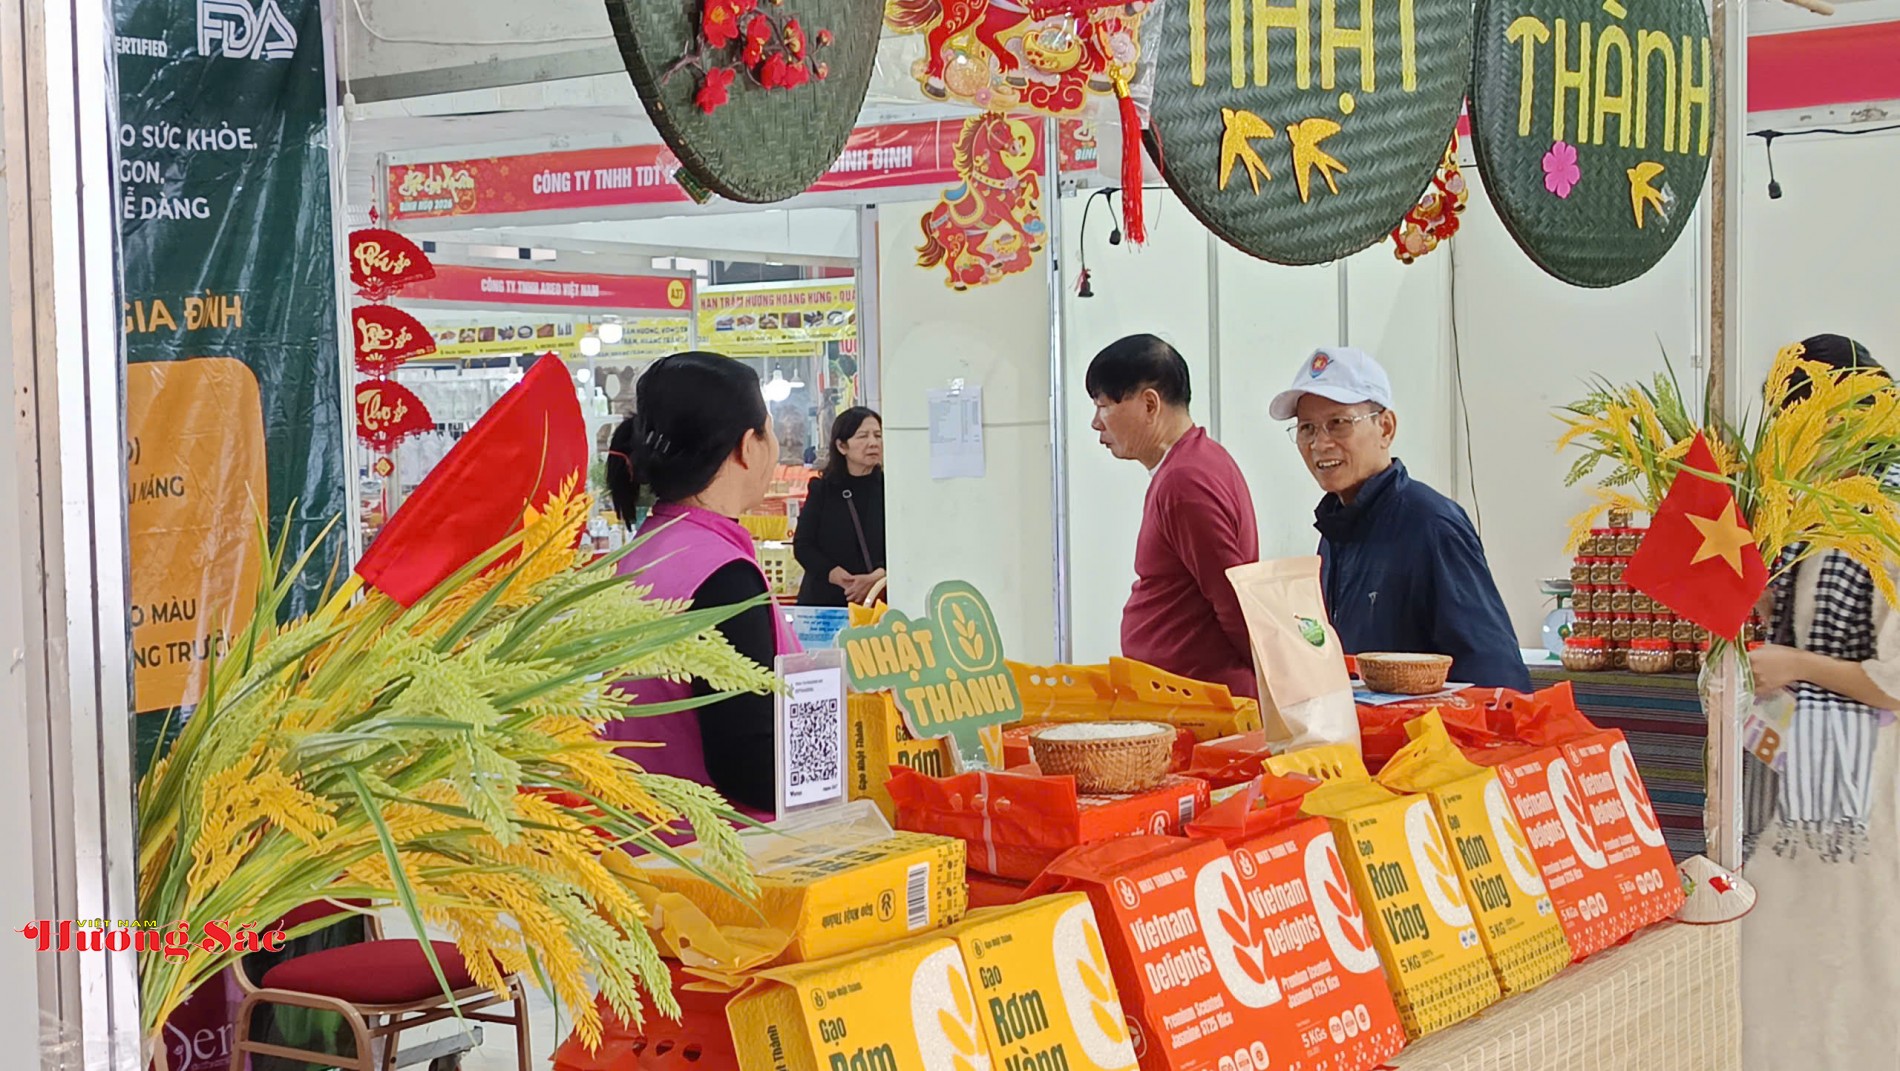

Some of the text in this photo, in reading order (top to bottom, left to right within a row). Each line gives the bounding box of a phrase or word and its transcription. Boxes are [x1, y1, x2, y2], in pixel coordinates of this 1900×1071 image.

[197, 0, 298, 60] FDA
[142, 121, 182, 150] SỨC
[186, 121, 258, 151] KHỎE.
[120, 159, 165, 185] GON.
[872, 145, 913, 174] ĐỊNH
[532, 168, 571, 195] CÔNG
[574, 172, 593, 191] TY
[594, 167, 632, 190] TNHH
[140, 191, 210, 220] DÀNG
[481, 276, 505, 294] CÔNG
[505, 280, 516, 293] TY
[562, 280, 579, 299] VIỆT
[184, 288, 242, 330] ĐÌNH
[357, 388, 391, 431] Thọ
[151, 595, 196, 625] MÀU
[846, 621, 936, 682] NHẬT
[905, 667, 1015, 726] THÀNH
[895, 725, 913, 746] Gạ
[1578, 771, 1616, 798] Vietnam
[1513, 790, 1555, 820] Vietnam
[1589, 797, 1626, 826] Delights
[1526, 818, 1567, 850] Delights
[1456, 834, 1492, 871] Rơm
[1366, 861, 1410, 901] Rơm
[1469, 871, 1512, 913] Vàng
[1247, 877, 1308, 919] Vietnam
[1129, 906, 1198, 953] Vietnam
[1263, 913, 1321, 957] Delights
[1381, 901, 1430, 945] Vàng
[1488, 925, 1497, 940] 5
[1496, 922, 1507, 937] KG
[979, 965, 1002, 992] Gạo
[1144, 945, 1212, 995] Delights
[1400, 958, 1409, 974] 5
[1408, 954, 1422, 970] KG
[819, 1017, 847, 1046] Gạo
[988, 989, 1049, 1047] Rơm
[767, 1024, 784, 1062] Thành
[1301, 1033, 1311, 1049] 5
